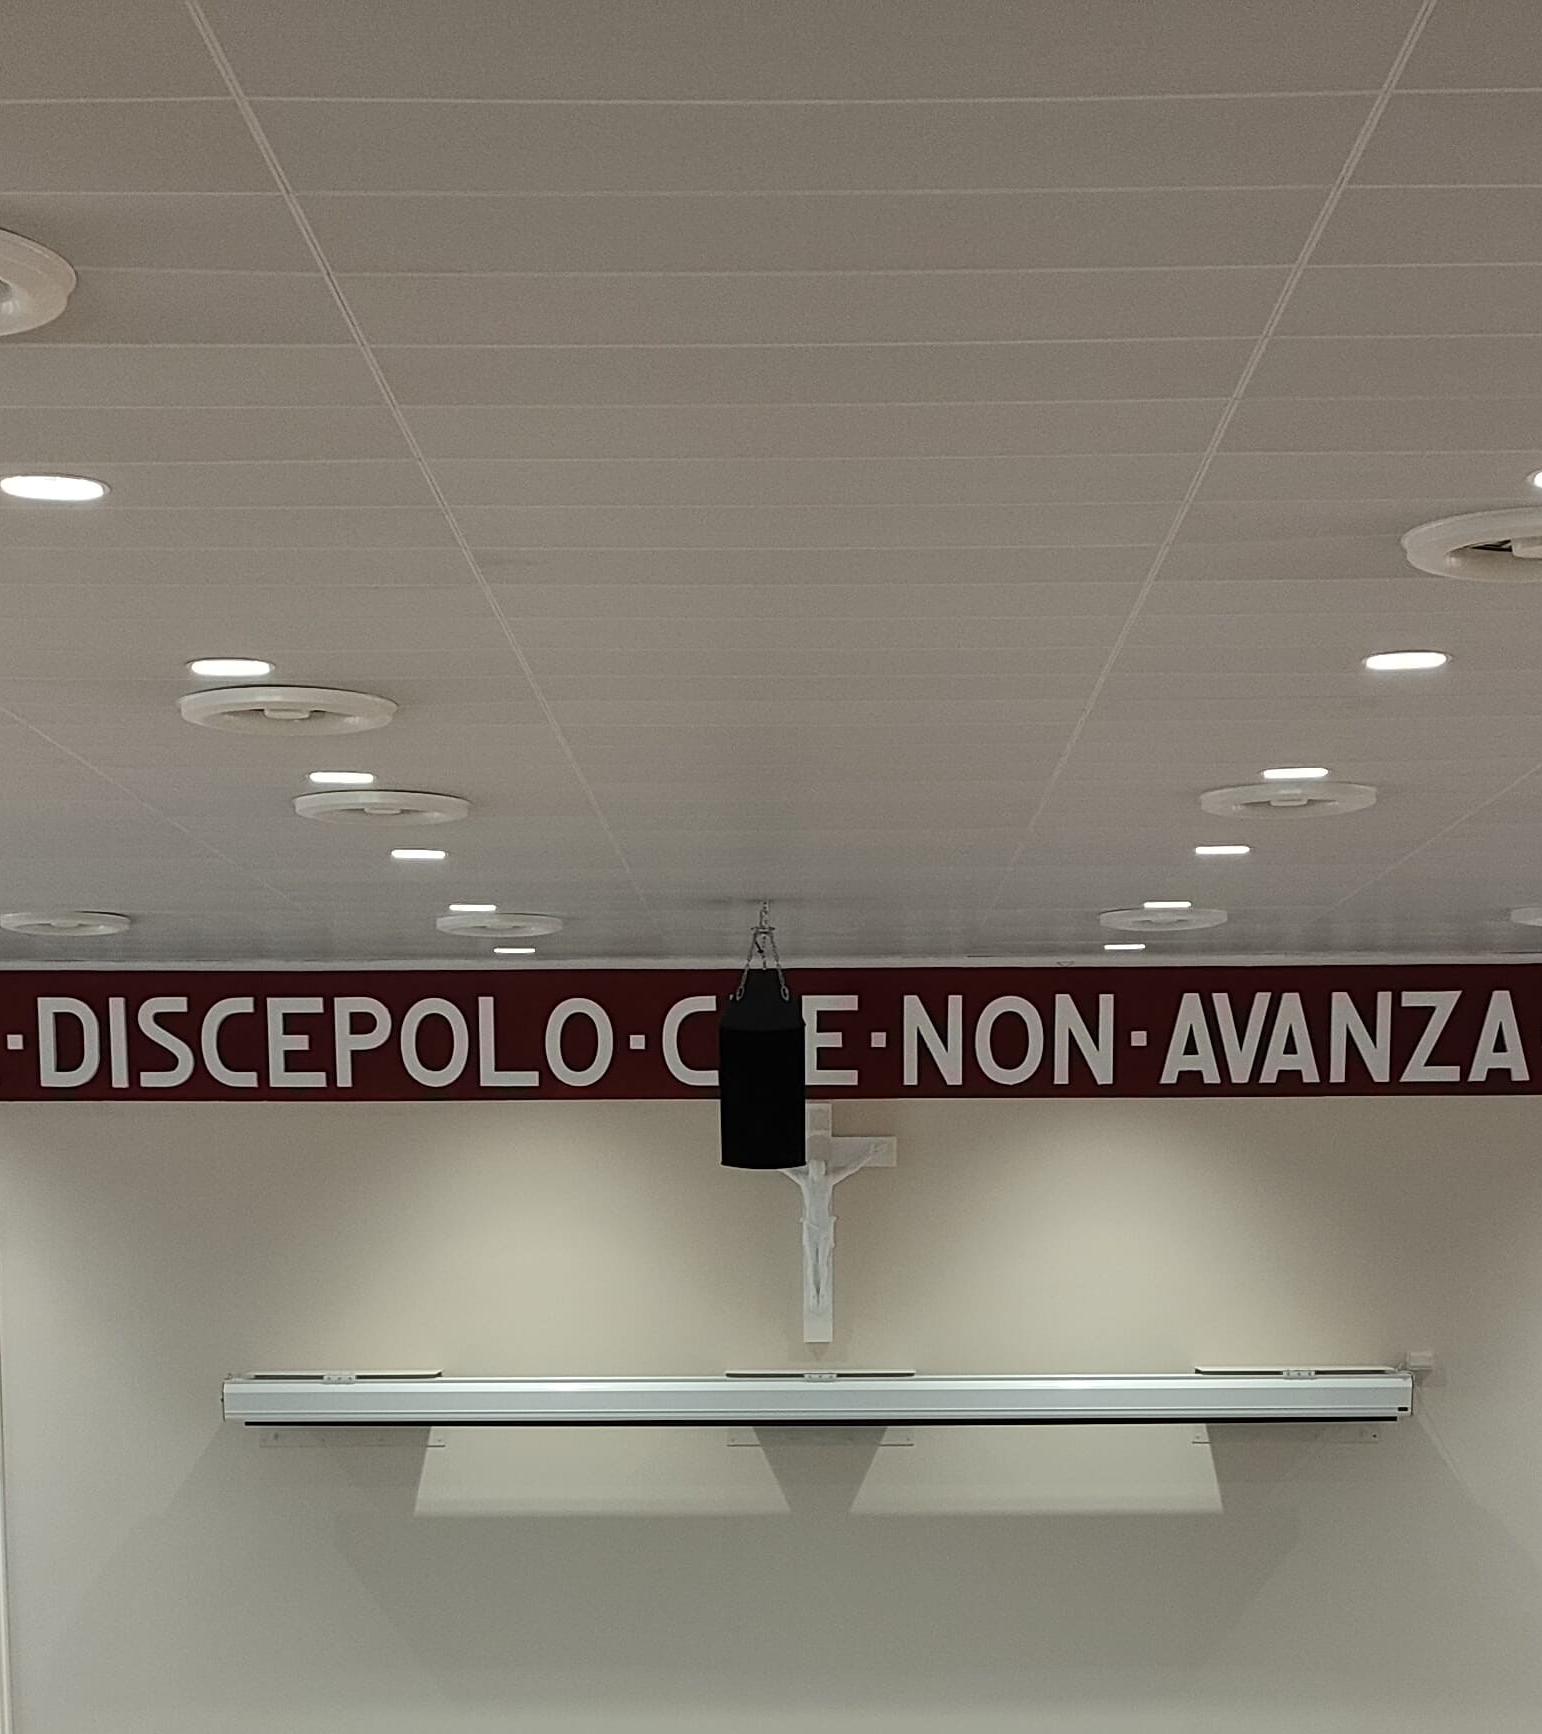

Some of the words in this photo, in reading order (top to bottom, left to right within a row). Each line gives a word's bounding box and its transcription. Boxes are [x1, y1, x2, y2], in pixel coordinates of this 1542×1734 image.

[37, 995, 614, 1088] DISCEPOLO
[662, 994, 858, 1087] CE
[903, 993, 1114, 1086] NON
[1160, 990, 1529, 1084] AVANZA
